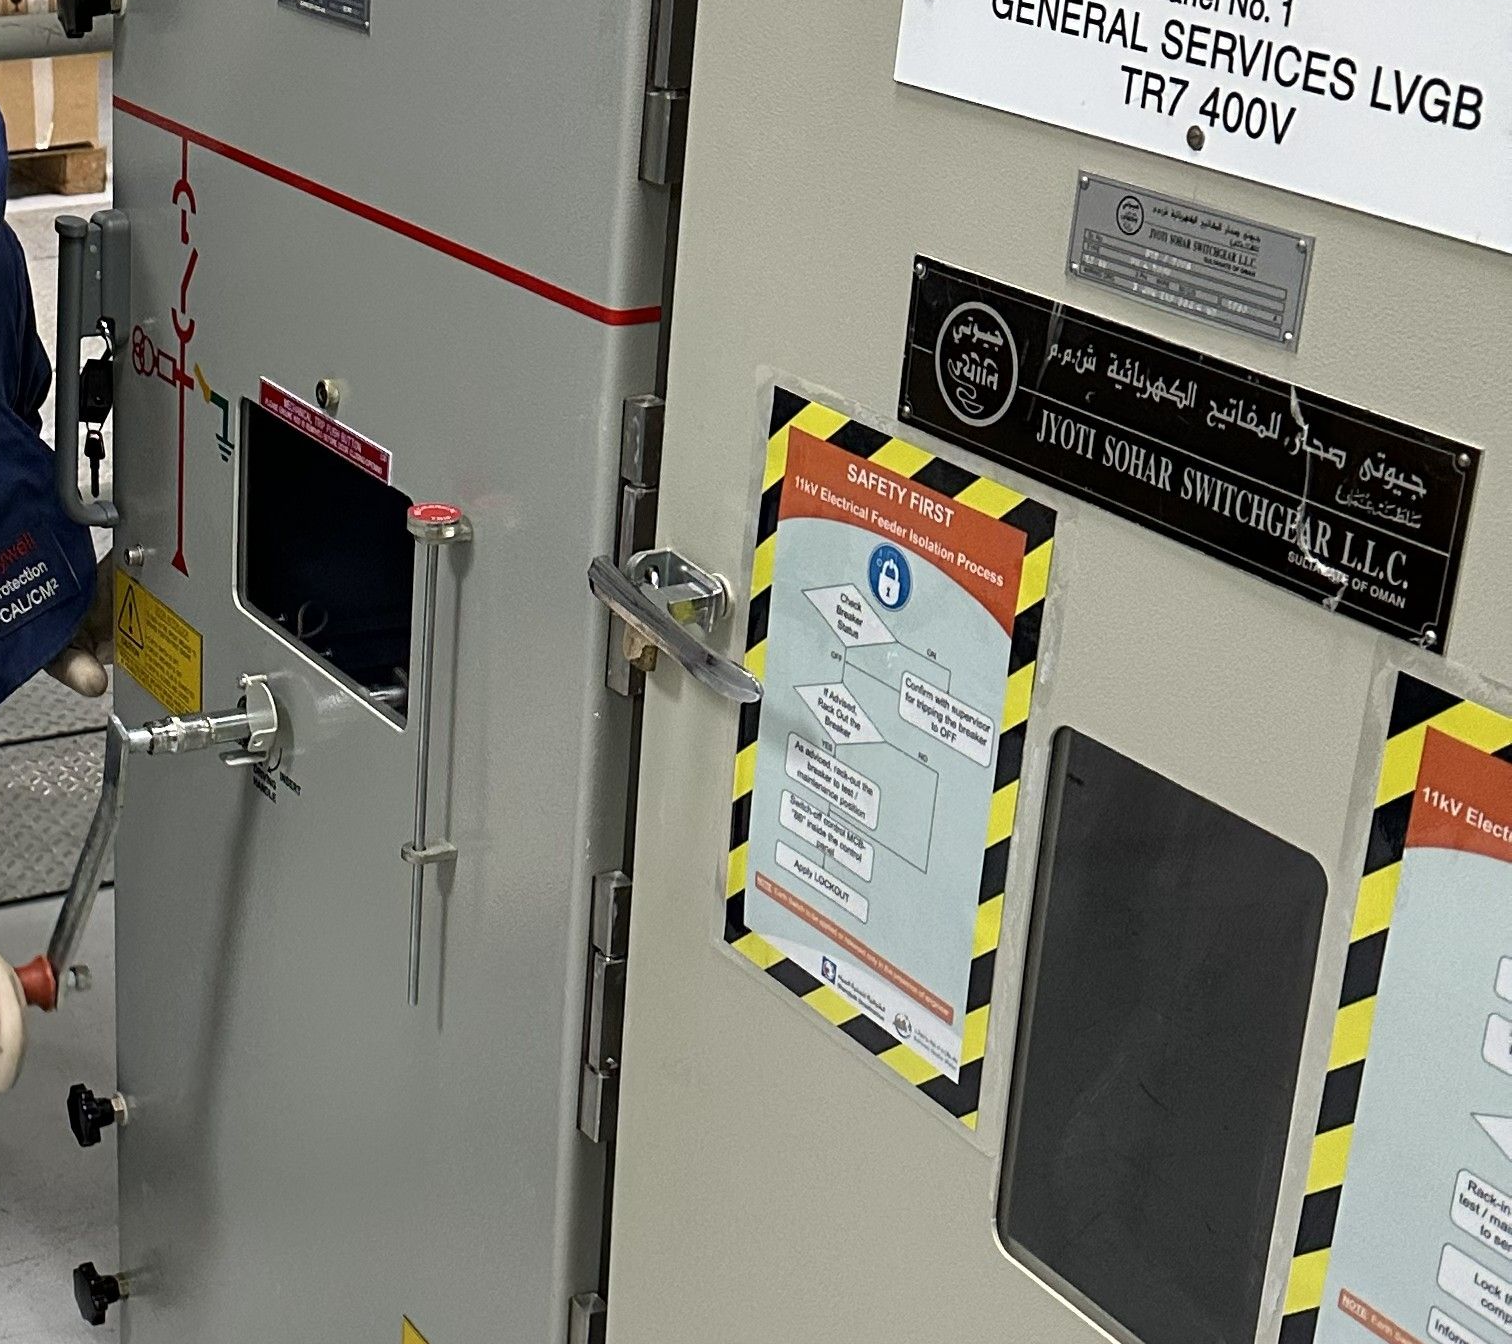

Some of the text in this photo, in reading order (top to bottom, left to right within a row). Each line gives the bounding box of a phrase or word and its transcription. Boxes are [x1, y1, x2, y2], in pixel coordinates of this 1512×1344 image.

[1161, 19, 1358, 102] SERVICES
[1370, 66, 1485, 131] LVGB
[1120, 65, 1297, 146] TR7 400V
[1193, 240, 1237, 262] SWITCHGEAR
[953, 317, 1004, 351] جيوتي
[1107, 352, 1198, 410] الكهربائية
[1206, 398, 1282, 440] للمفاتيح
[847, 463, 955, 528] SAFETY FIRST
[1036, 409, 1409, 589] JYOTI SOHAR SWITCHGEAR L.L.C.
[794, 475, 1004, 588] 11kV Electrical Feeder Isolation Process
[840, 593, 862, 612] Check
[1351, 578, 1406, 609] OF OMAN
[836, 604, 864, 627] Breaker
[838, 620, 859, 640] Status
[818, 697, 861, 732] Rack Out the
[905, 677, 991, 733] Confirm with supervisor
[905, 691, 987, 746] for tripping the breaker
[825, 716, 851, 739] Breaker
[931, 722, 957, 743] to OFF
[280, 771, 301, 796] INSERT
[794, 740, 873, 796] As rack-out the
[807, 761, 832, 784] breaker
[833, 779, 840, 789] to
[841, 784, 853, 798] test
[797, 769, 866, 820] maintenance position
[1422, 786, 1463, 816] 11kV
[806, 818, 862, 862] inside the control
[823, 814, 846, 837] control
[794, 859, 849, 902] Apply LOCKOUT
[1459, 1193, 1481, 1218] test
[1479, 1224, 1491, 1240] to
[1474, 1272, 1502, 1299] Lock
